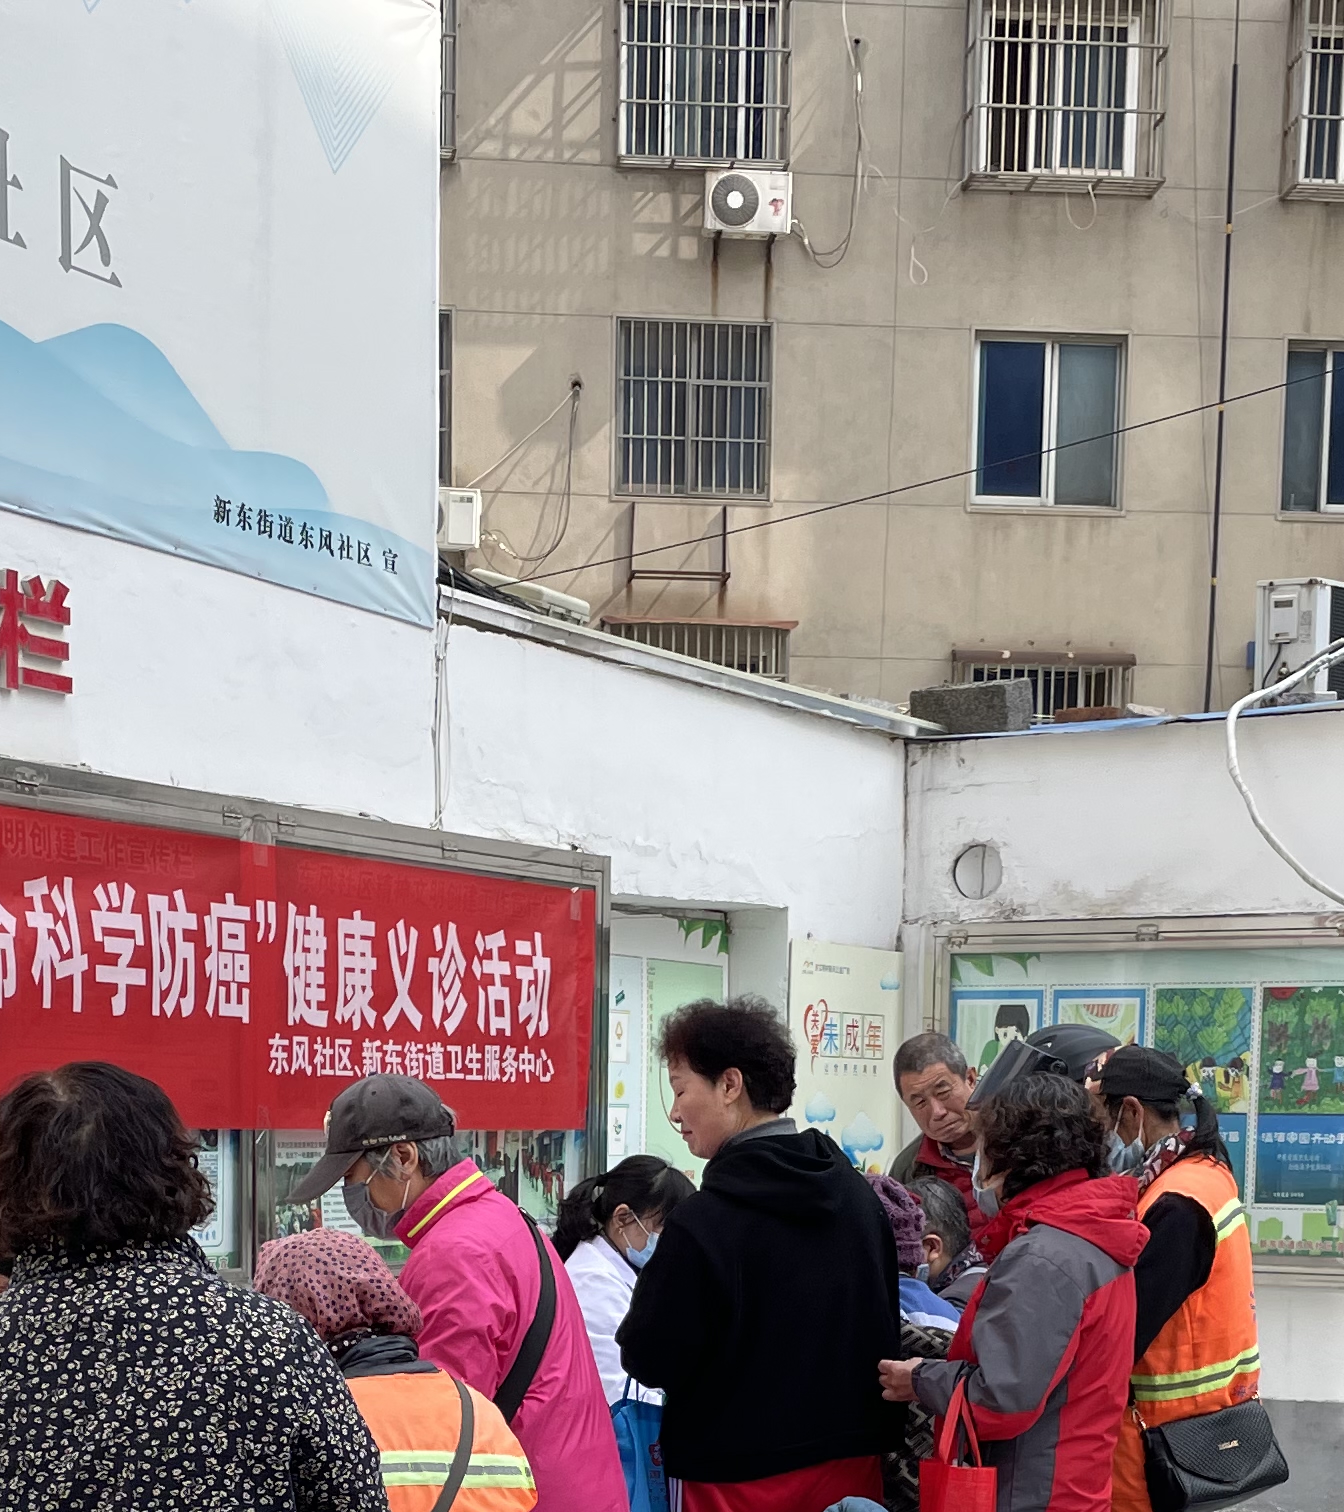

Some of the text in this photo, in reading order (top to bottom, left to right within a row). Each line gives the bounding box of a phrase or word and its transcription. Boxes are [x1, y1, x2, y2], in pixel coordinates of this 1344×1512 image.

[212, 493, 399, 577] 新东街道东风社区 宣
[267, 1033, 555, 1084] 东风社区、新东街道卫生服务中心
[823, 1016, 883, 1058] 未成年
